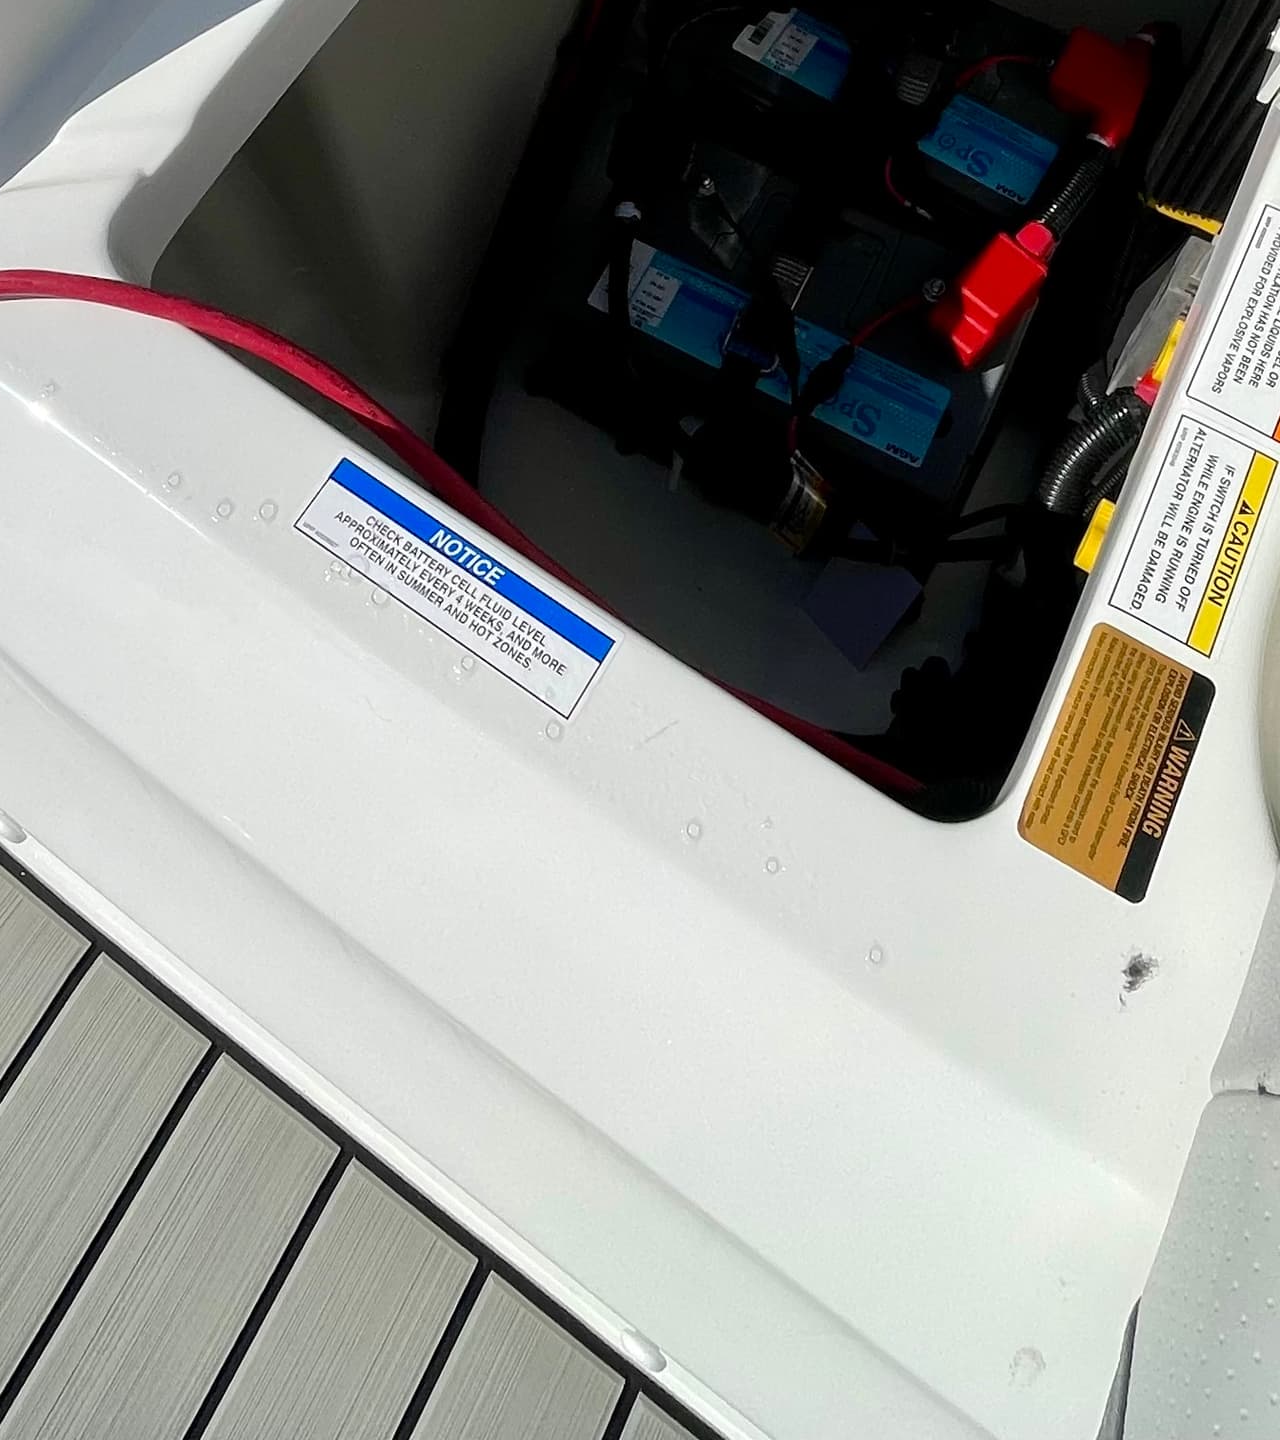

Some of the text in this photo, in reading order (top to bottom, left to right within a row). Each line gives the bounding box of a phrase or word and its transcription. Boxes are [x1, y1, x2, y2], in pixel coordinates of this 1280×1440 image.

[995, 181, 1027, 204] AGM
[1249, 274, 1268, 298] FOR
[1227, 295, 1259, 353] EXPLOSIVE
[1252, 309, 1271, 334] HAS
[1243, 331, 1262, 356] NOT
[1210, 350, 1237, 396] VAPORS
[1231, 353, 1253, 386] BEEN
[1247, 357, 1268, 389] HERE
[1264, 369, 1280, 390] OR
[884, 439, 921, 465] AGM
[1171, 426, 1208, 502] ALTERNATOR
[1153, 452, 1219, 605] WHILE ENGINE IS RUNNING
[1159, 499, 1180, 531] WILL
[1152, 529, 1168, 549] BE
[1172, 463, 1236, 612] IF SWITCH IS TURNED OFF
[427, 525, 506, 589] NOTICE
[1206, 518, 1250, 608] CAUTION
[332, 508, 421, 575] APPROXIMATELY
[417, 567, 456, 600] EVERY
[452, 591, 465, 606] 4
[461, 597, 508, 636] WEEKS,
[504, 627, 533, 653] AND
[529, 645, 568, 678] MORE
[363, 513, 405, 547] CHECK
[400, 539, 452, 580] BATTERY
[448, 572, 479, 598] CELL
[477, 592, 514, 623] FLUID
[510, 614, 550, 648] LEVEL
[1127, 547, 1161, 614] DAMAGED.
[347, 535, 536, 672] OFTEN IN SUMMER AND HOT ZONES.
[1155, 667, 1179, 713] EXPLOSION
[1172, 672, 1188, 700] AVOID
[1150, 710, 1163, 726] OR
[1159, 696, 1179, 734] SERIOUS
[1133, 722, 1158, 774] ELECTRICAL
[1144, 760, 1156, 776] OR
[1134, 773, 1152, 804] DEATH
[1140, 742, 1190, 842] WARNING
[1124, 800, 1141, 829] FROM
